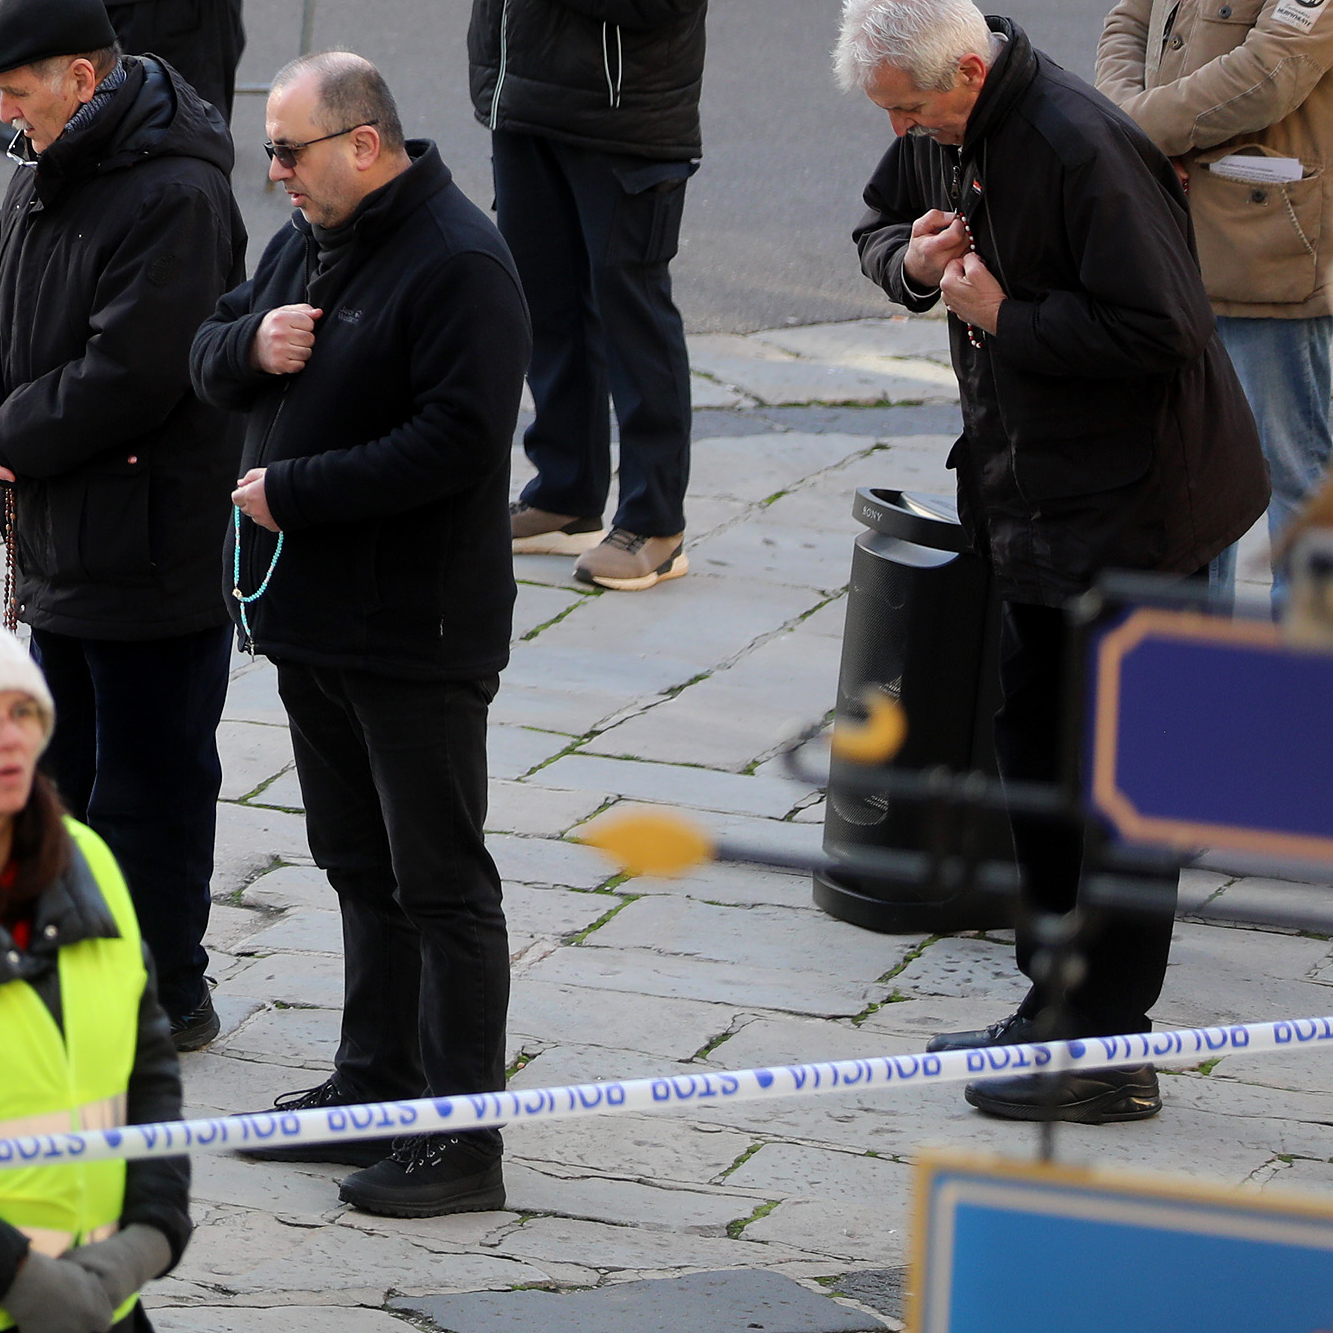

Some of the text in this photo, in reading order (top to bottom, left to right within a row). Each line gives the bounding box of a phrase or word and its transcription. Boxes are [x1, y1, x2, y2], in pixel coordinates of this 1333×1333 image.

[861, 505, 883, 522] SONY
[965, 1045, 1051, 1072] STOP
[652, 1073, 738, 1101] STOP
[328, 1102, 417, 1130] STOP
